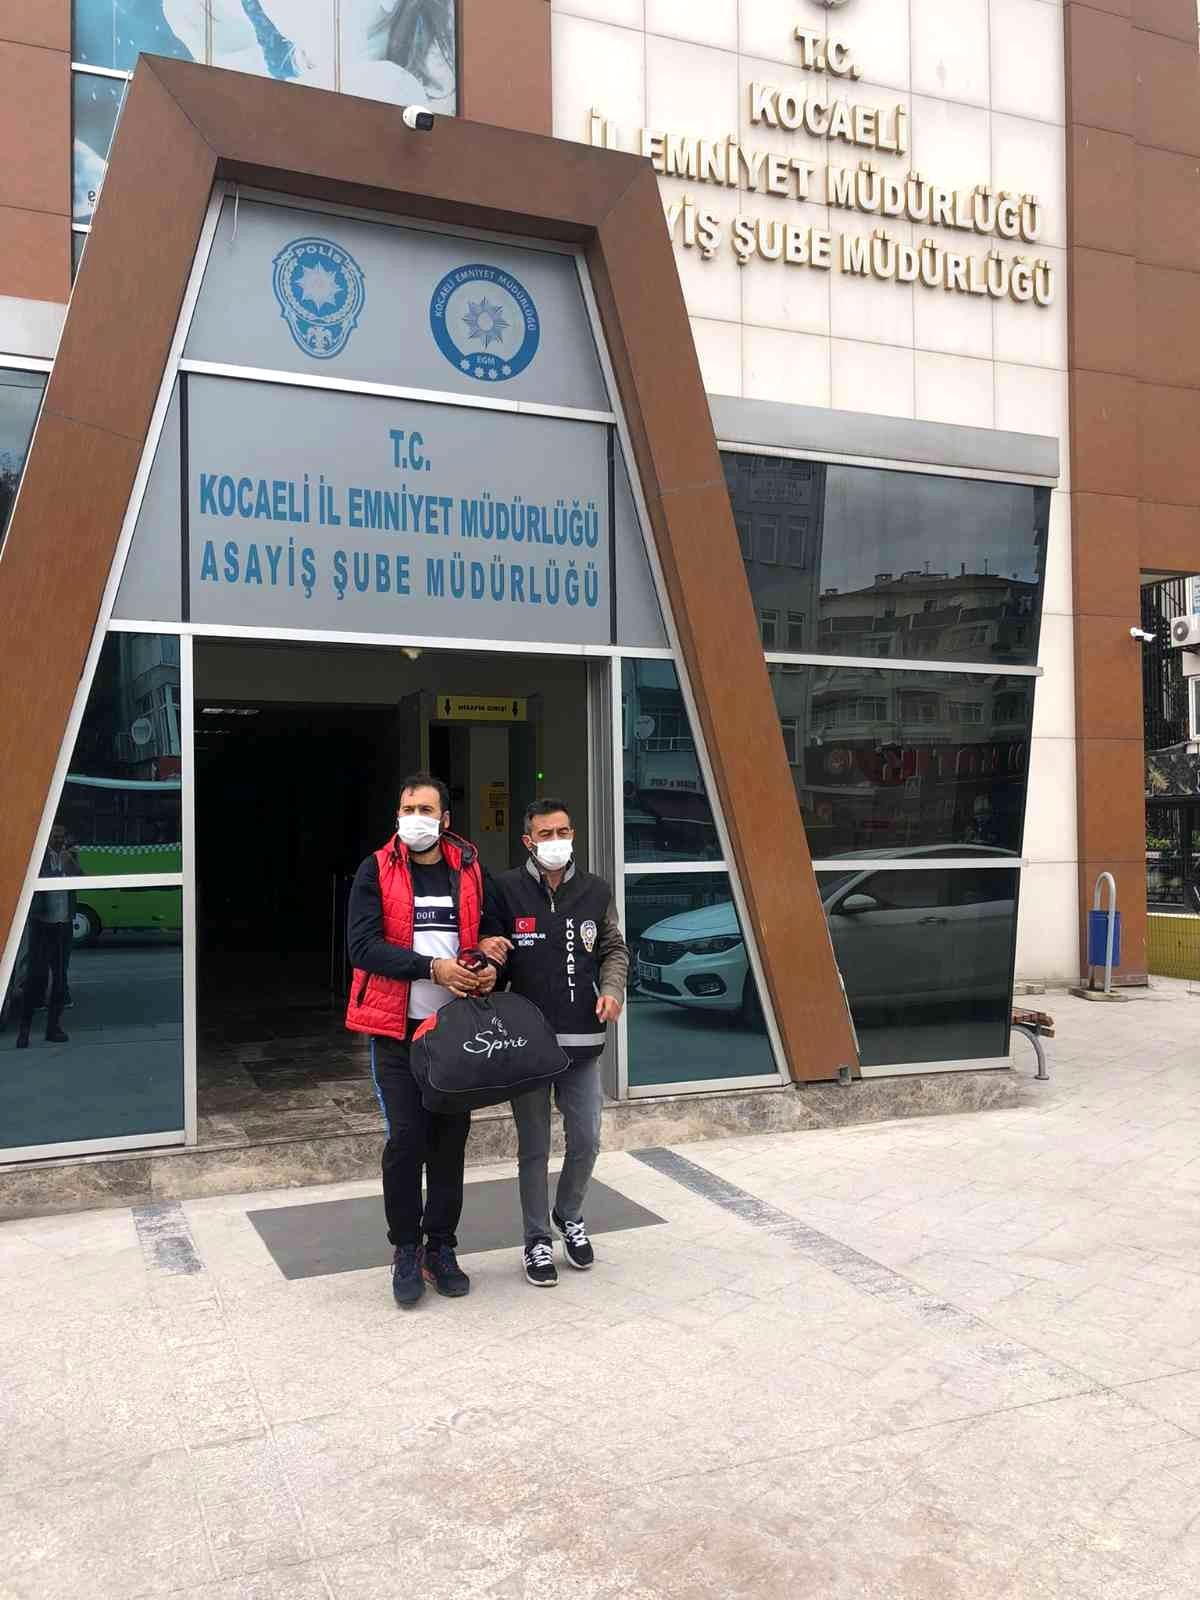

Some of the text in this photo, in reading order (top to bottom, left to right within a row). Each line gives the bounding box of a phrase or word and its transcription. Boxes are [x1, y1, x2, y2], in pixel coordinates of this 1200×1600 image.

[795, 25, 864, 80] T.C.
[750, 81, 908, 155] KOCAELİ
[640, 127, 815, 200] EMNİYET
[826, 161, 1041, 243] MÜDÜRLÜĞÜ
[667, 194, 1055, 306] YİŞ ŞUBE MÜDÜRLÜĞÜ
[389, 429, 431, 471] T.C.
[200, 473, 599, 548] KOCAELİ İL EMNİYET MÜDÜRLÜĞÜ
[200, 536, 599, 608] ASAYİŞ ŞUBE MÜDÜRLÜĞÜ
